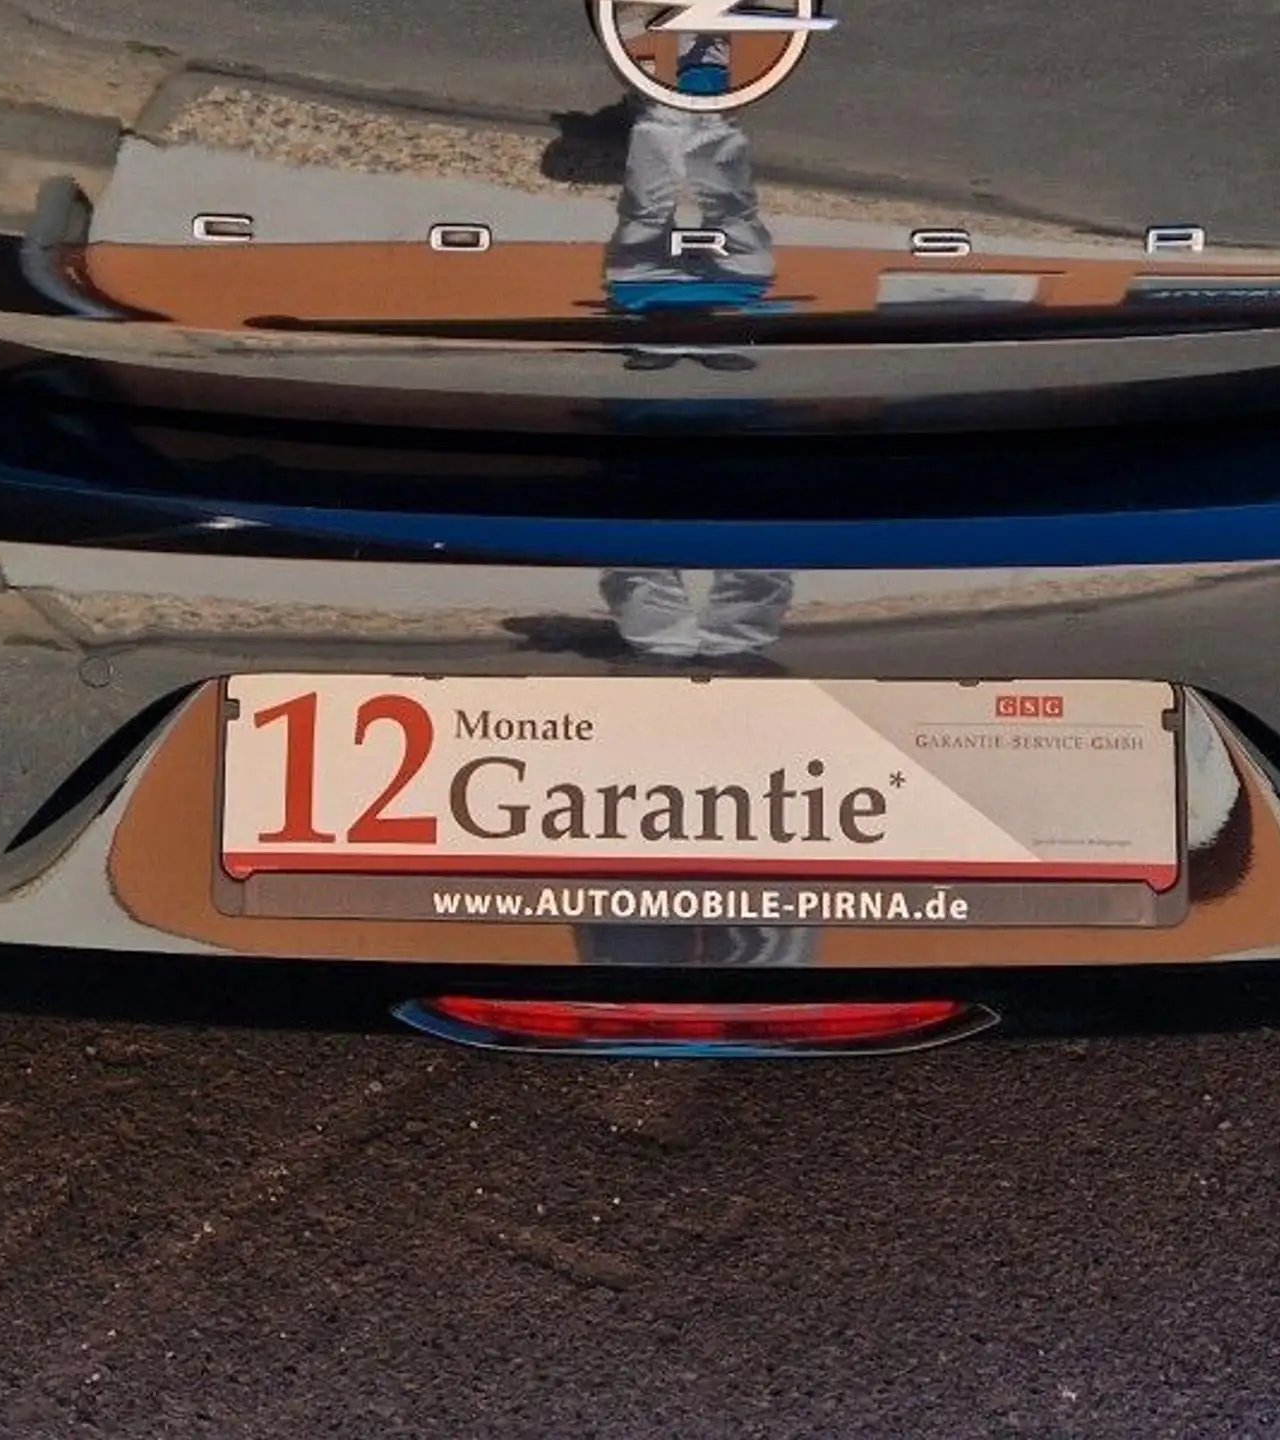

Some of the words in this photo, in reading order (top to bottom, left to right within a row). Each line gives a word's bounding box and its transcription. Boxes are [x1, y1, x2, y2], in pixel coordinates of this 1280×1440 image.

[192, 213, 1206, 259] CORSA
[997, 697, 1062, 716] GSG
[454, 709, 594, 742] Monate
[253, 691, 438, 845] 12
[432, 886, 969, 921] www.AUTOMOBILE-PIRNA.de
